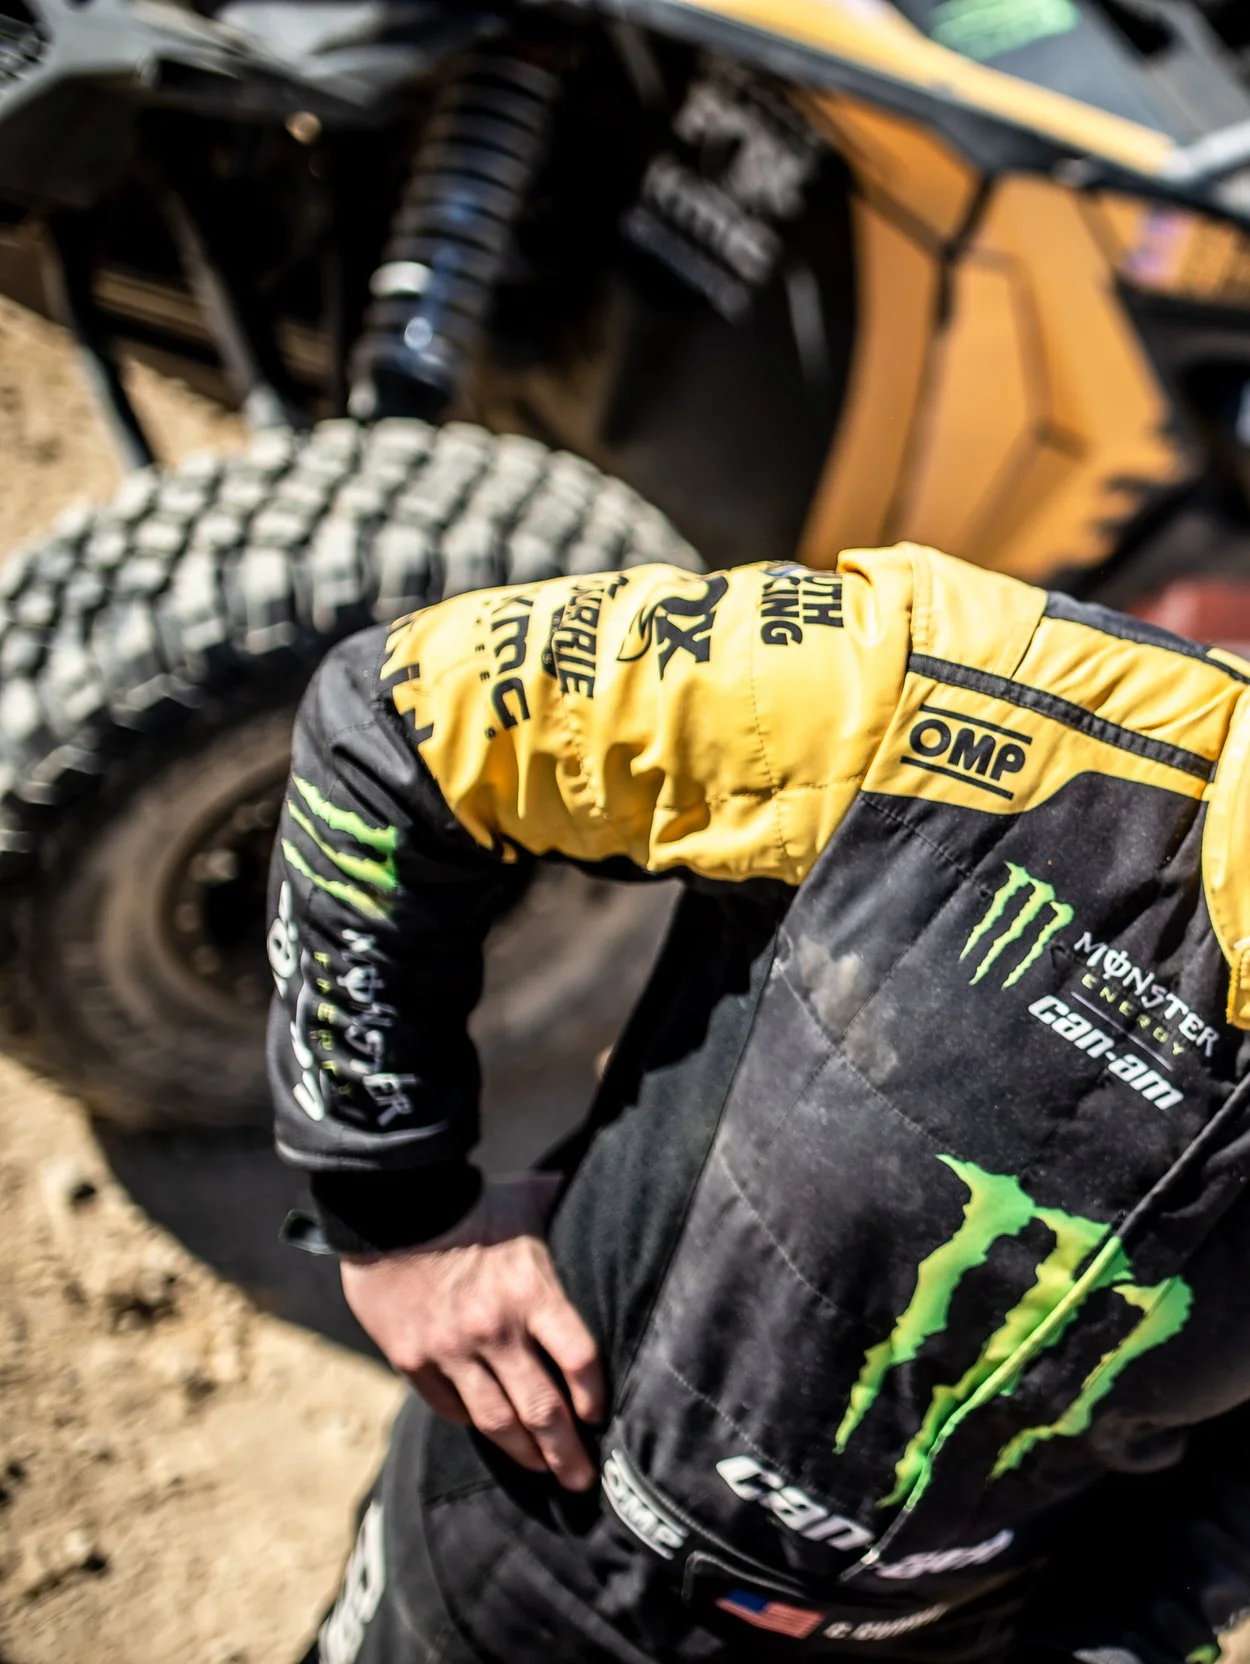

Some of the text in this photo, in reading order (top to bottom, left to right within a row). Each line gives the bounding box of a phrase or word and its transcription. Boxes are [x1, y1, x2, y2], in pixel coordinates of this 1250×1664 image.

[908, 718, 1027, 783] OMP
[1027, 994, 1185, 1112] can-am
[1081, 972, 1185, 1057] ENERGY
